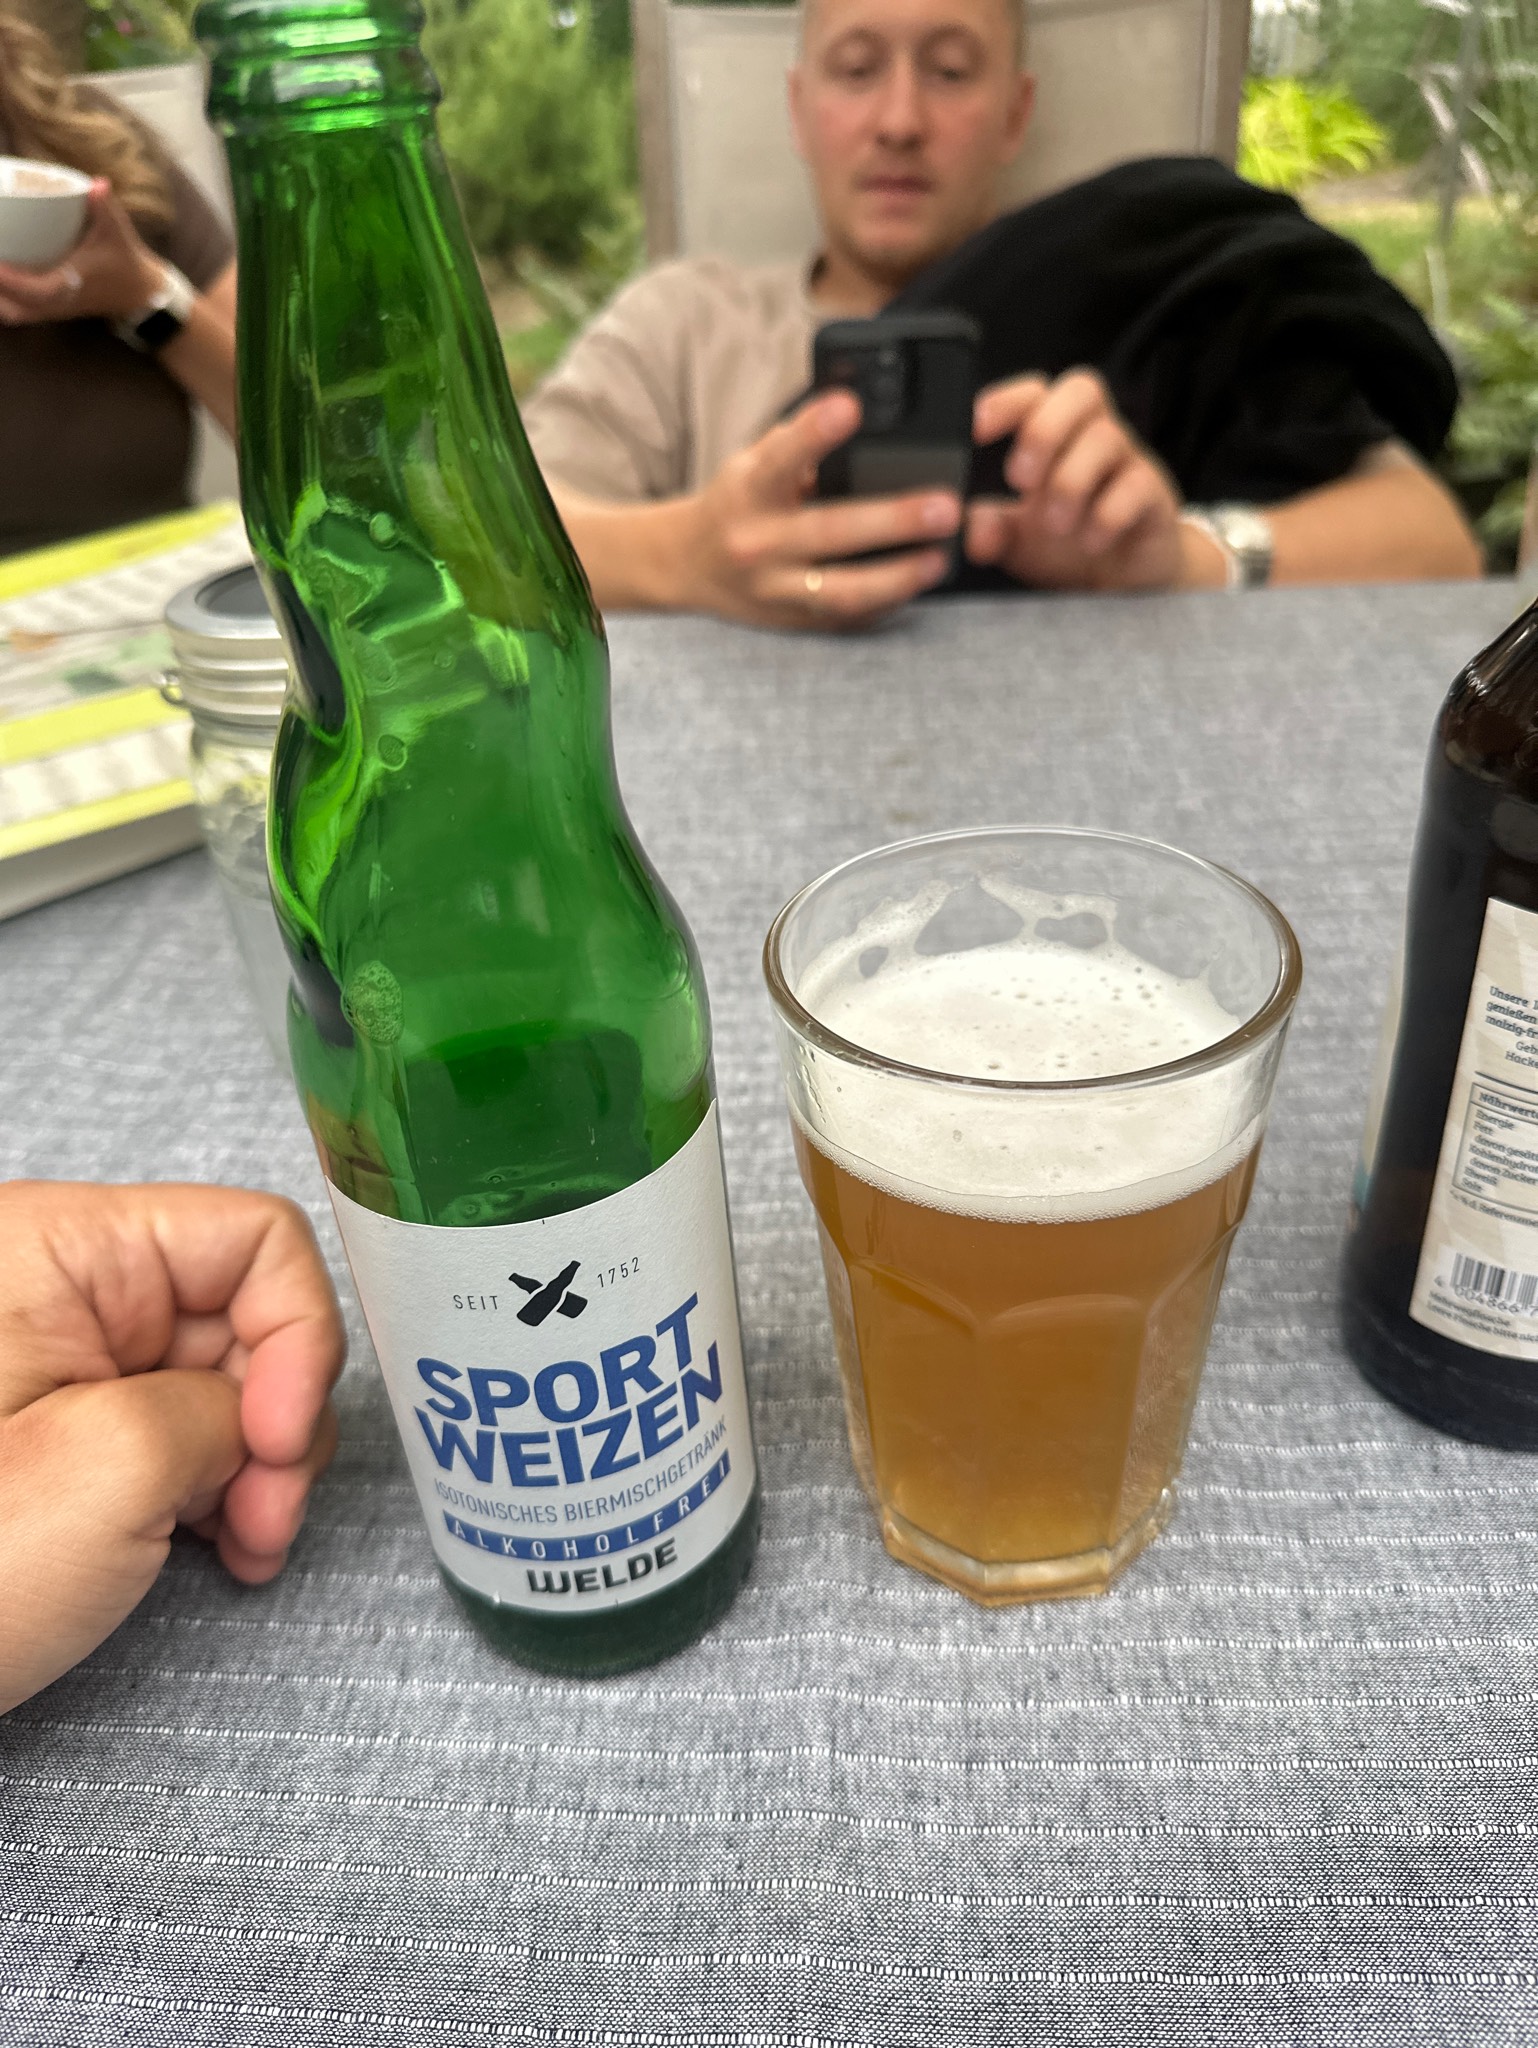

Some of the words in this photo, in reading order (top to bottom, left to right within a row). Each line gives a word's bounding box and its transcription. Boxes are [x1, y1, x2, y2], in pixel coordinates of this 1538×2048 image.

[1486, 1001, 1537, 1025] genießen
[1489, 985, 1529, 1008] Unsere
[452, 1294, 499, 1311] SEIT
[596, 1256, 641, 1288] 1752
[416, 1291, 699, 1427] SPORT
[414, 1339, 723, 1488] WEIZEN
[434, 1477, 559, 1524] ISOTONISCHES
[564, 1414, 728, 1523] BIERMISCHGETRÄNK
[453, 1460, 727, 1560] ALKOHOLFREI
[526, 1536, 679, 1595] WELDE
